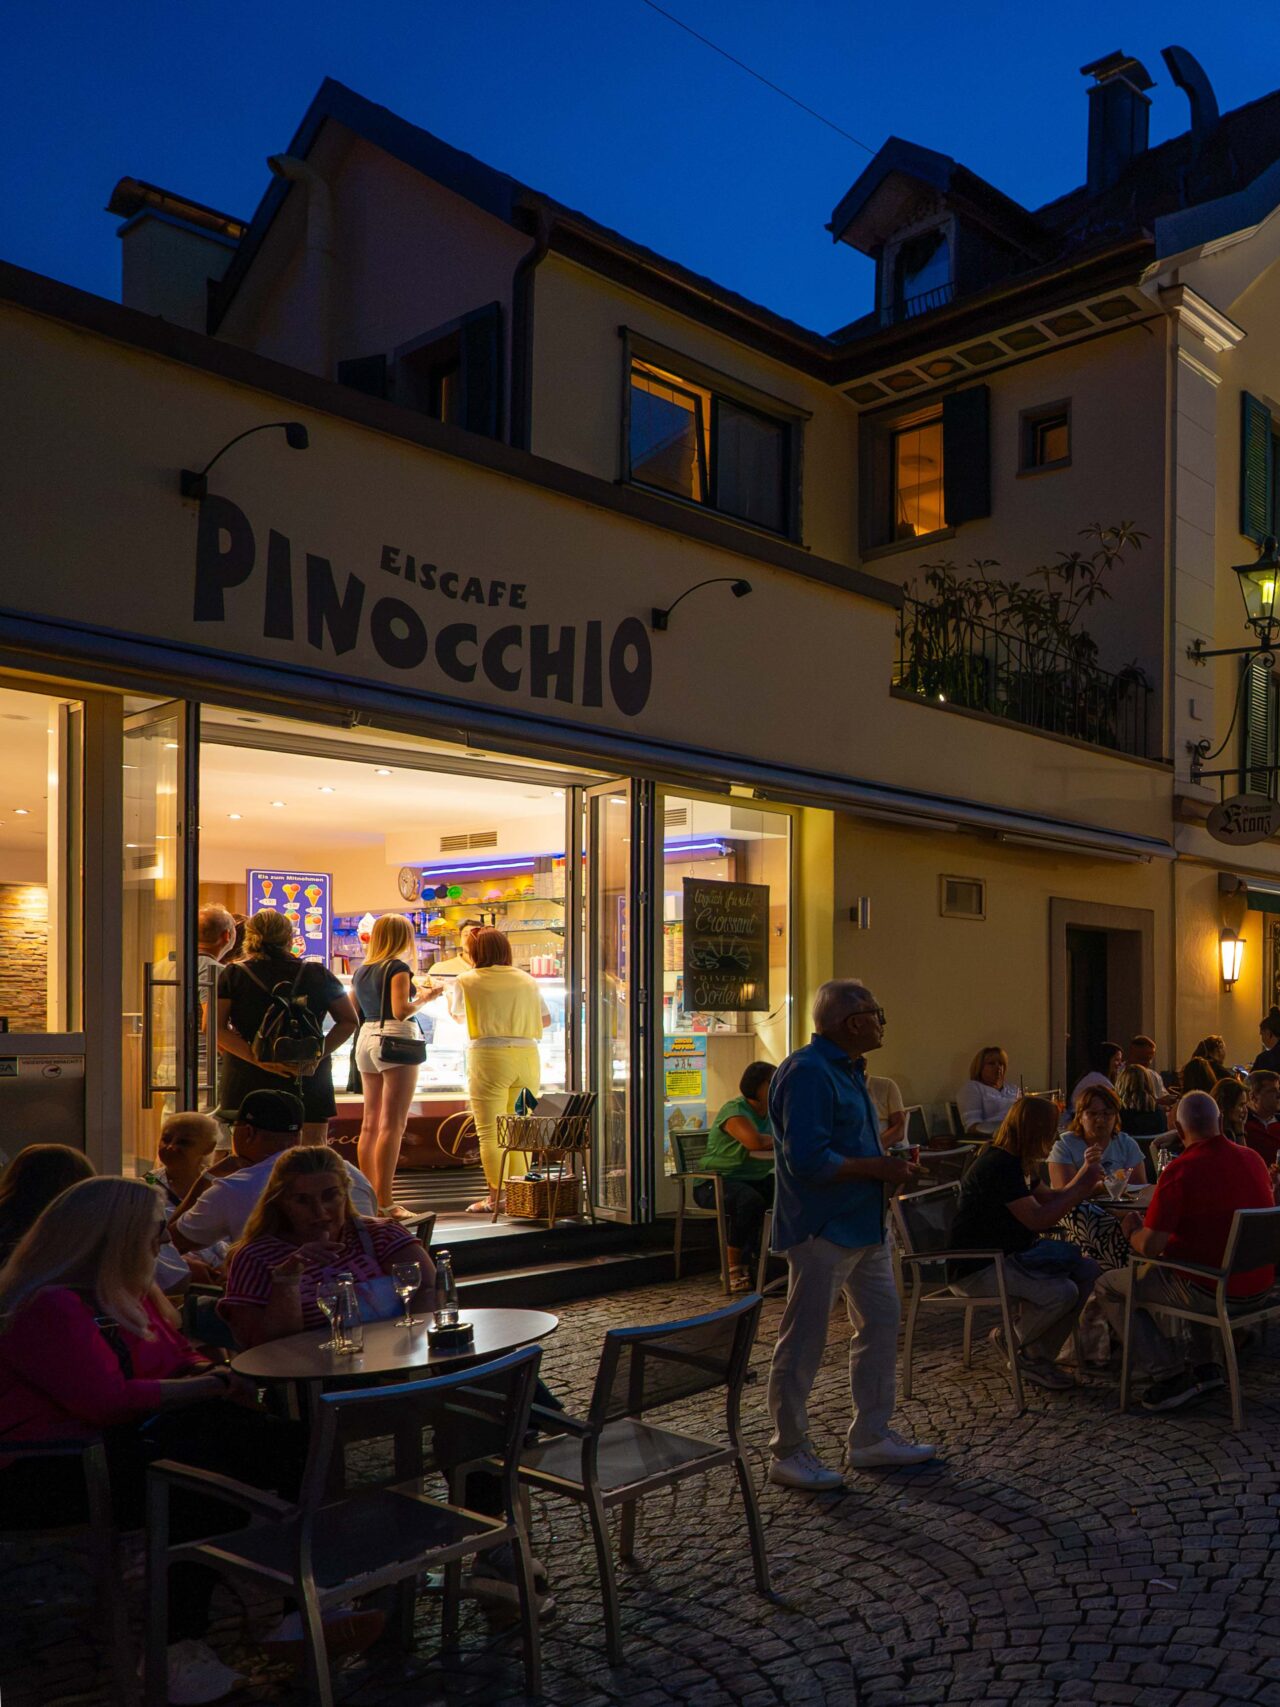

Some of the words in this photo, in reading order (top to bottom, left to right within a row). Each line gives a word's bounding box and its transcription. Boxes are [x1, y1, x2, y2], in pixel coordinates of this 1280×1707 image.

[380, 544, 527, 610] EISCAFE
[193, 493, 653, 717] PINOCCHIO
[1219, 804, 1272, 834] Kranz
[694, 907, 757, 934] Croissant
